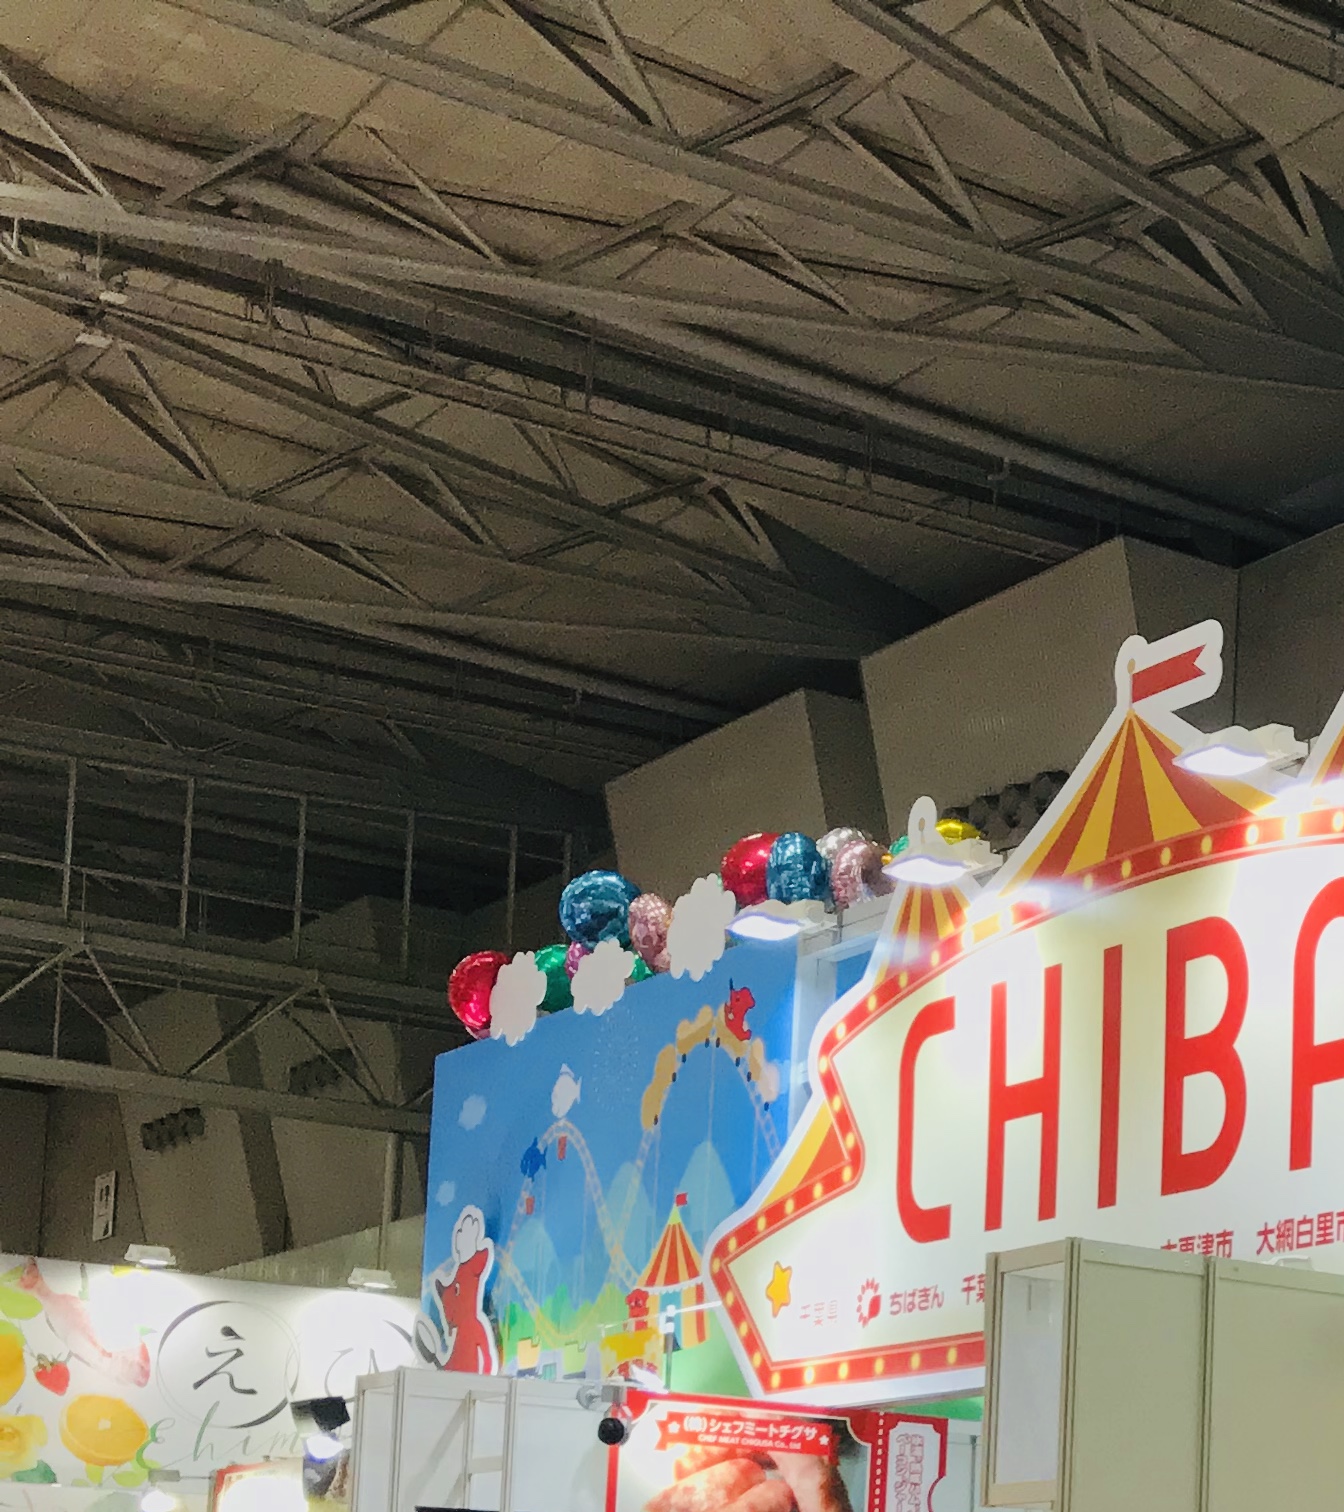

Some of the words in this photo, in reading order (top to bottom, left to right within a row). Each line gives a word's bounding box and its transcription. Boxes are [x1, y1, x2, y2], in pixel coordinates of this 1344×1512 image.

[889, 1284, 944, 1316] ちばぎん
[193, 1325, 258, 1395] え
